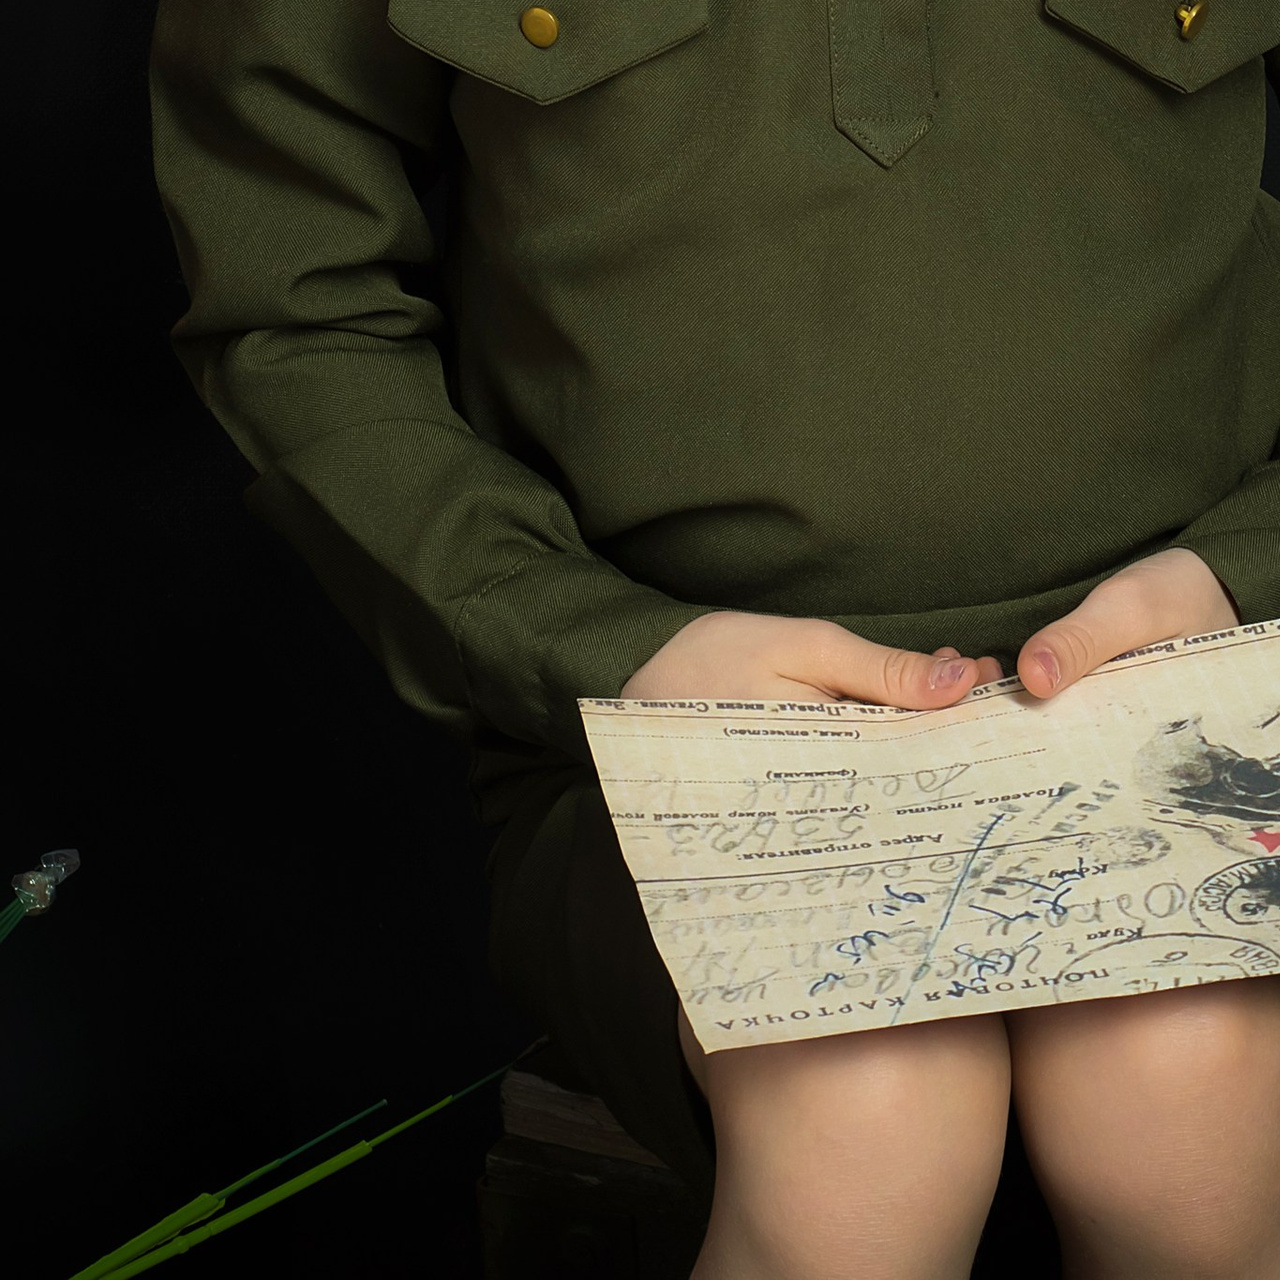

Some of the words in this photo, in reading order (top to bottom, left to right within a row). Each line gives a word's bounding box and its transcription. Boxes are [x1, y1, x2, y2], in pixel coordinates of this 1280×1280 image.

[1242, 621, 1266, 636] По
[587, 697, 626, 710] Зак.
[633, 696, 709, 713] Сталина.
[973, 785, 1065, 806] Полевая
[785, 803, 870, 823] (Указать
[895, 798, 963, 816] почта
[727, 810, 777, 824] номер
[738, 838, 873, 861] отправителя:
[879, 833, 944, 847] Адрес
[1086, 924, 1145, 946] Куда
[923, 961, 1110, 1002] ПОЧТОВАЯ
[714, 996, 906, 1031] КАРТОЧКА
